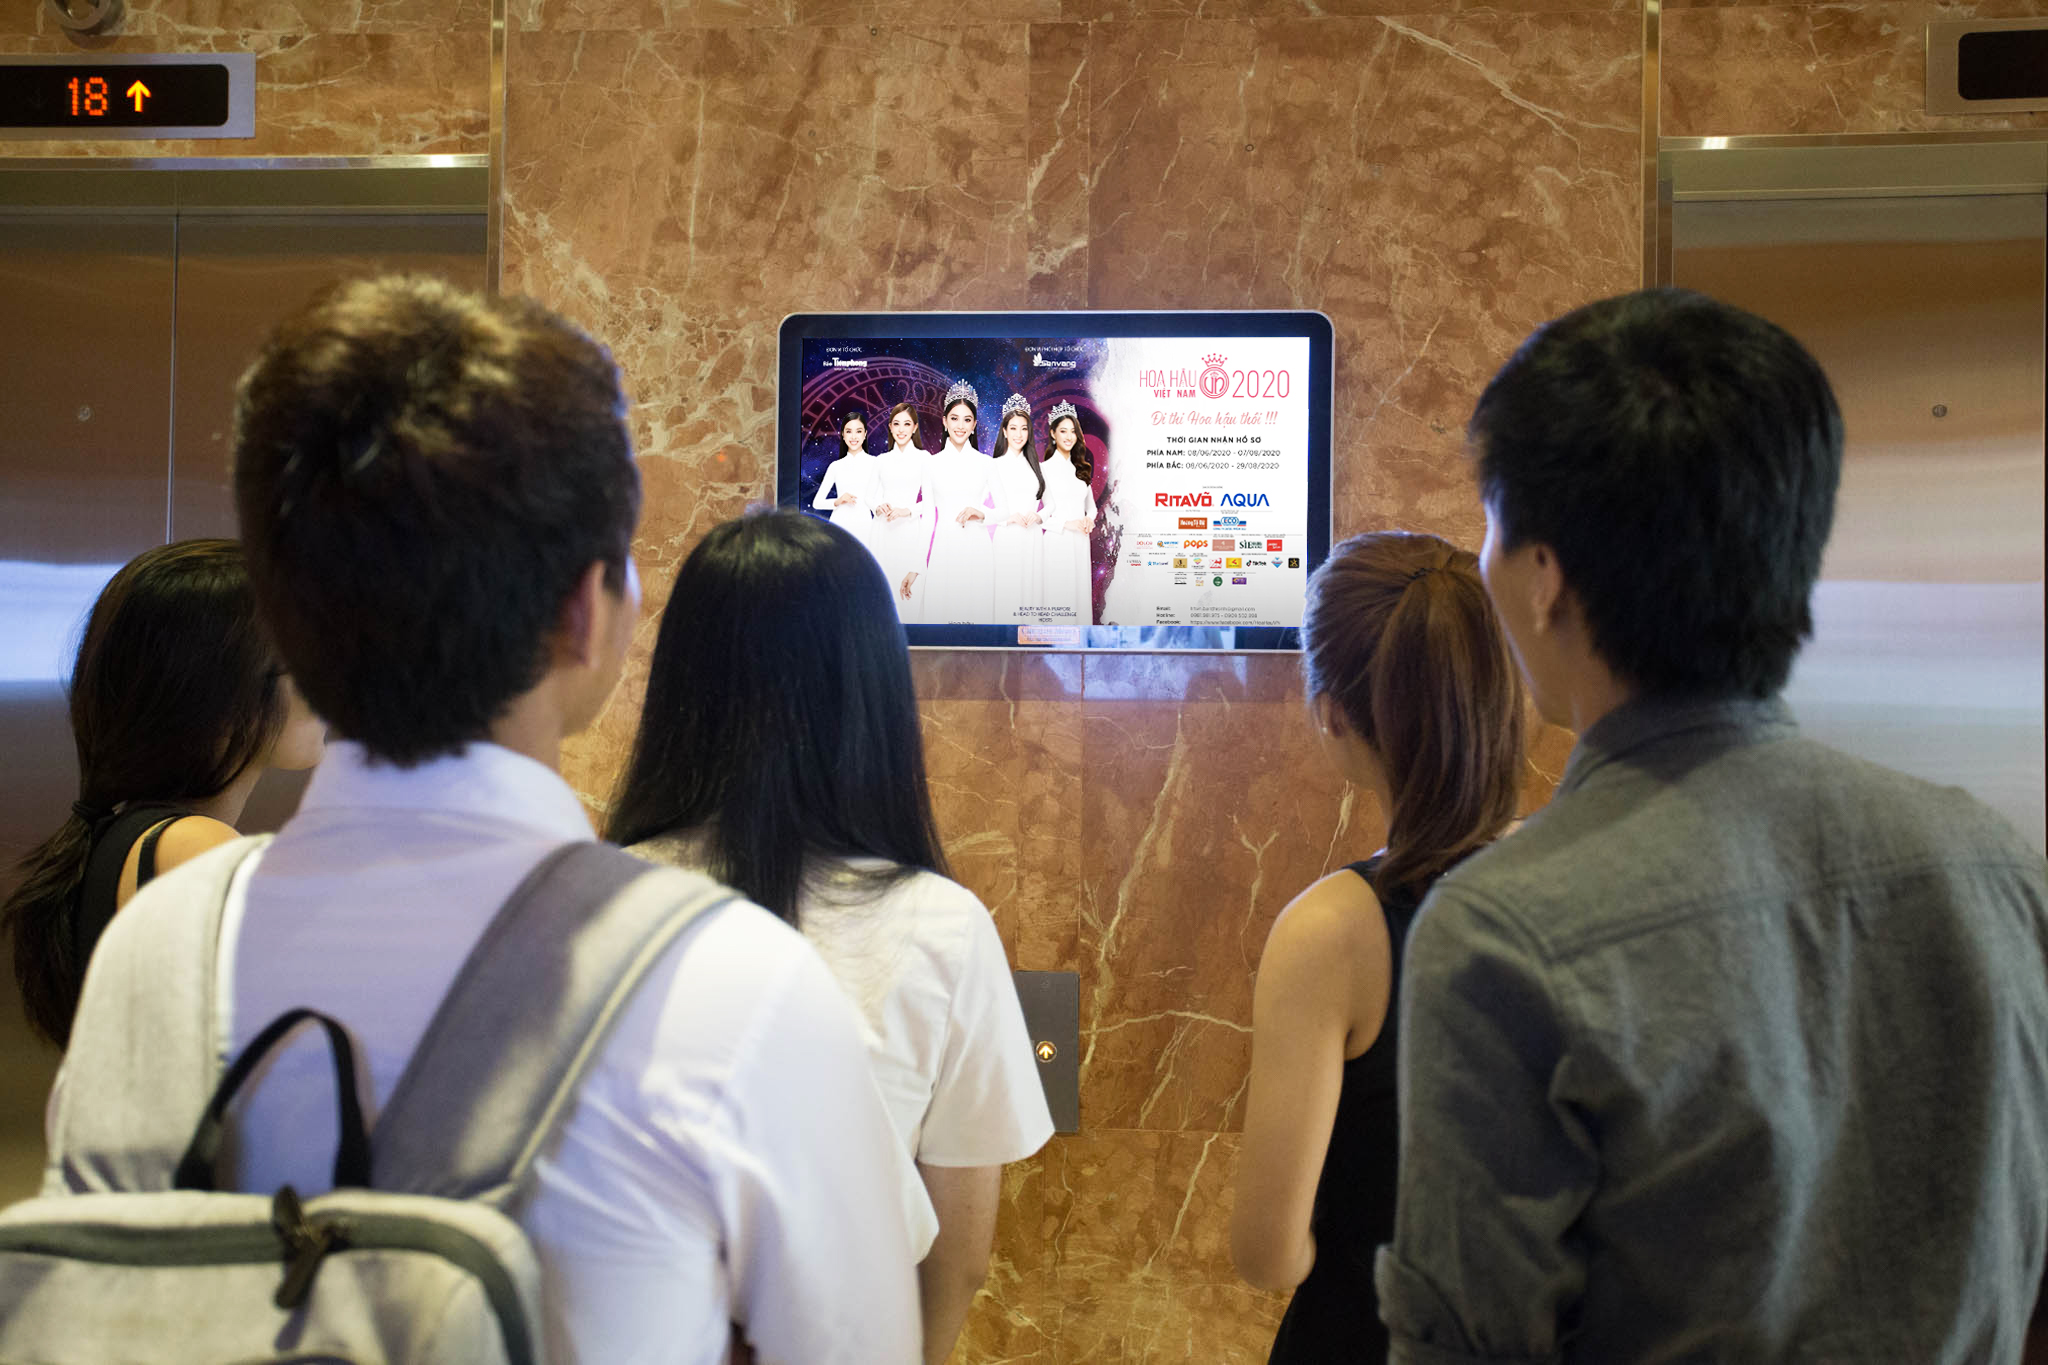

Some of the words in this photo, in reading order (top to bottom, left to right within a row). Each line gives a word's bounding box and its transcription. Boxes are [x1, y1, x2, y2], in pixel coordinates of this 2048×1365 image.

[68, 76, 108, 116] 18
[1139, 369, 1166, 387] HOA
[1170, 367, 1197, 387] HẬU
[1232, 369, 1290, 398] 2020
[1154, 388, 1171, 399] VIỆT
[1177, 389, 1196, 398] NAM
[1150, 410, 1167, 425] Đi
[1168, 412, 1185, 424] thi
[1187, 410, 1212, 425] Hoa
[1215, 411, 1237, 428] hậu
[1220, 492, 1270, 507] AQUA
[1183, 539, 1209, 549] pops
